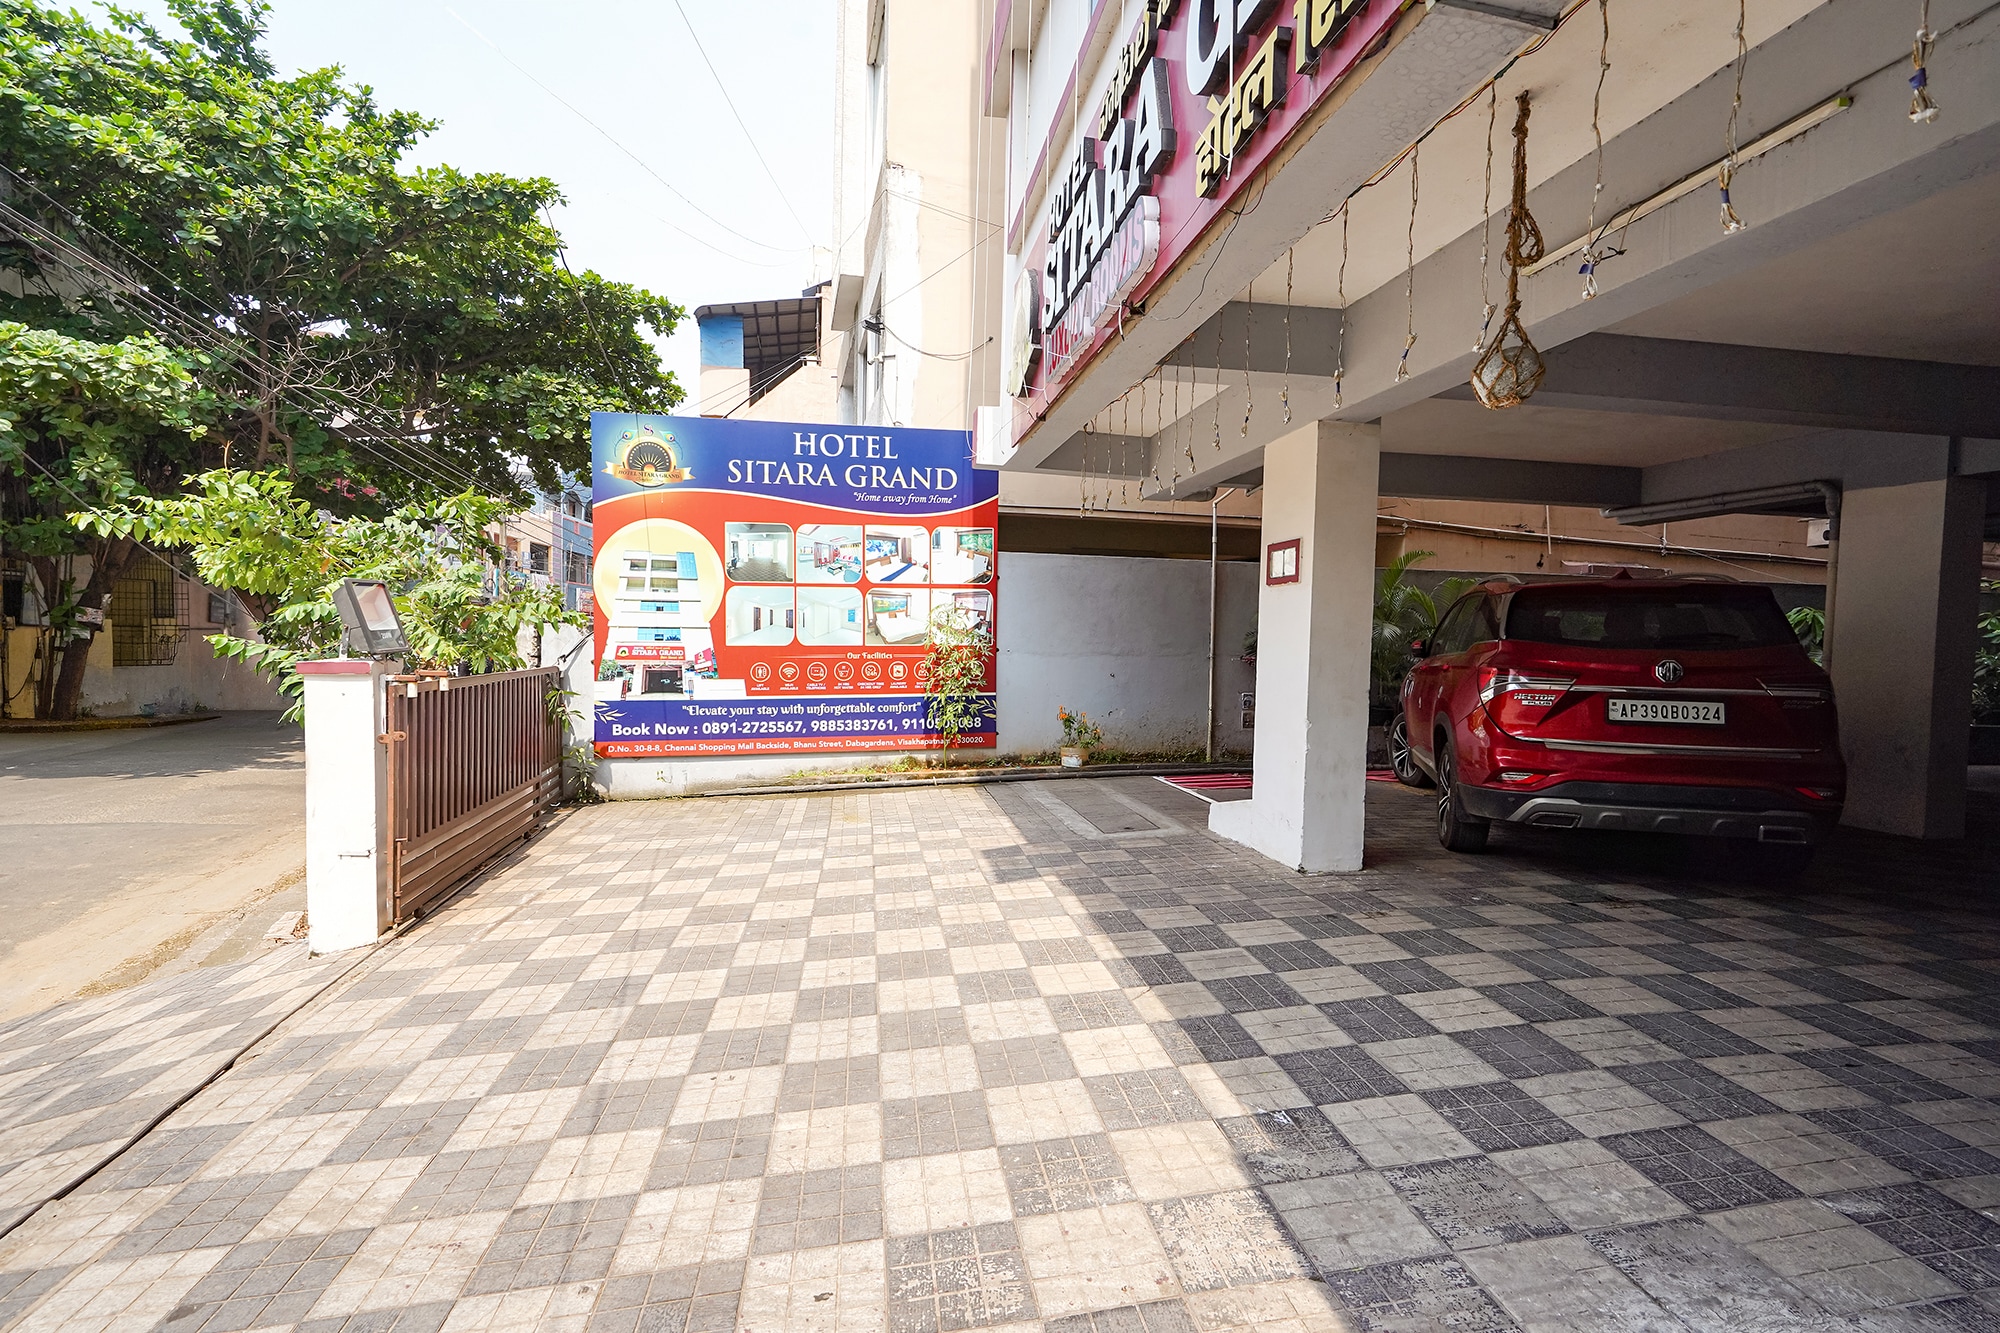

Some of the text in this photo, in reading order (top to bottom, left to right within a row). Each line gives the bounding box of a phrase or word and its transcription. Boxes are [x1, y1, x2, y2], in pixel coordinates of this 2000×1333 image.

[1195, 27, 1279, 198] होटल
[1042, 57, 1164, 334] SITARA
[1090, 202, 1146, 324] ROOMS
[792, 431, 899, 460] HOTEL
[727, 459, 958, 491] SITARA GRAND
[882, 494, 906, 506] away
[905, 493, 927, 506] from
[846, 651, 893, 660] Our Facilities
[1656, 660, 1683, 683] MG
[1514, 693, 1556, 701] HECTOR
[729, 706, 755, 719] your
[756, 706, 778, 718] stay
[780, 703, 804, 716] with
[806, 702, 876, 717] unforgettable
[1620, 703, 1721, 721] AP39QB0324
[612, 723, 651, 736] Book
[654, 722, 690, 736] Now
[702, 720, 807, 736] 0891-2725567,
[810, 719, 898, 732] 9885383761,
[608, 744, 632, 753] D.No.
[634, 744, 663, 753] 30-8-8,
[664, 743, 697, 752] Chennai
[698, 742, 736, 753] Shopping
[738, 741, 754, 750] Mall
[756, 741, 792, 751] Backside,
[793, 740, 817, 749] Bhanu
[818, 740, 844, 748] Street,
[846, 738, 896, 749] Dabagardens,
